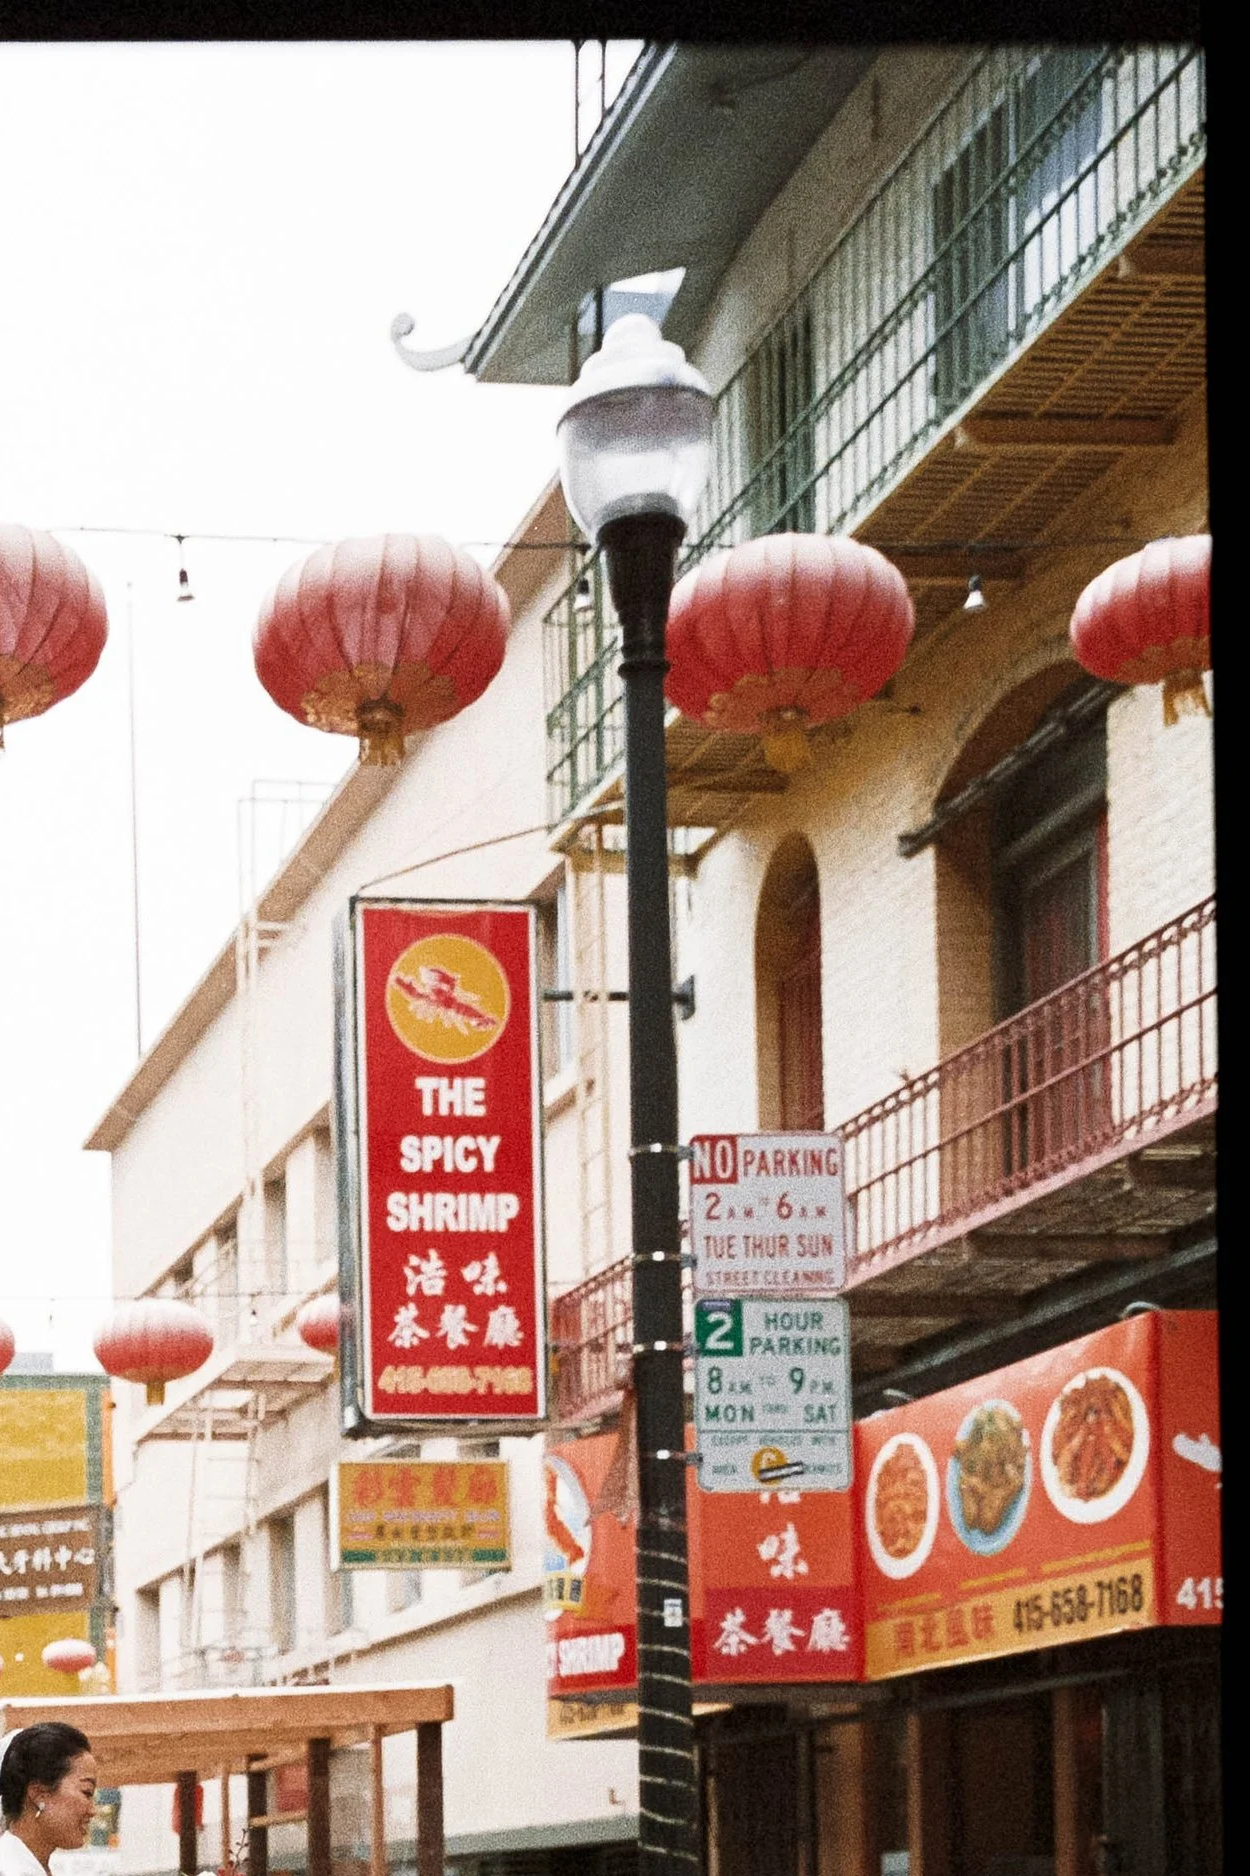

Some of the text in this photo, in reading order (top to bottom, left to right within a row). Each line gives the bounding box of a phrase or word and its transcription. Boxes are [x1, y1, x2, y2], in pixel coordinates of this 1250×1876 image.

[414, 1077, 487, 1117] THE
[400, 1135, 501, 1173] SPICY
[692, 1139, 839, 1179] NO PARKING
[386, 1191, 520, 1232] SHRIMP
[705, 1191, 721, 1221] 2
[777, 1191, 793, 1220] 6
[704, 1234, 833, 1259] TUE THUR SUN
[706, 1270, 835, 1285] STREET CLEANING
[387, 1302, 525, 1350] 茶餐廳
[705, 1311, 824, 1350] 2 HOUR
[750, 1336, 841, 1355] PARKING
[707, 1365, 723, 1394] 8
[789, 1366, 805, 1395] 9
[705, 1404, 755, 1423] MON
[803, 1404, 837, 1423] SAT
[1012, 1573, 1144, 1633] 415-658-7168
[712, 1606, 850, 1657] 茶餐廳
